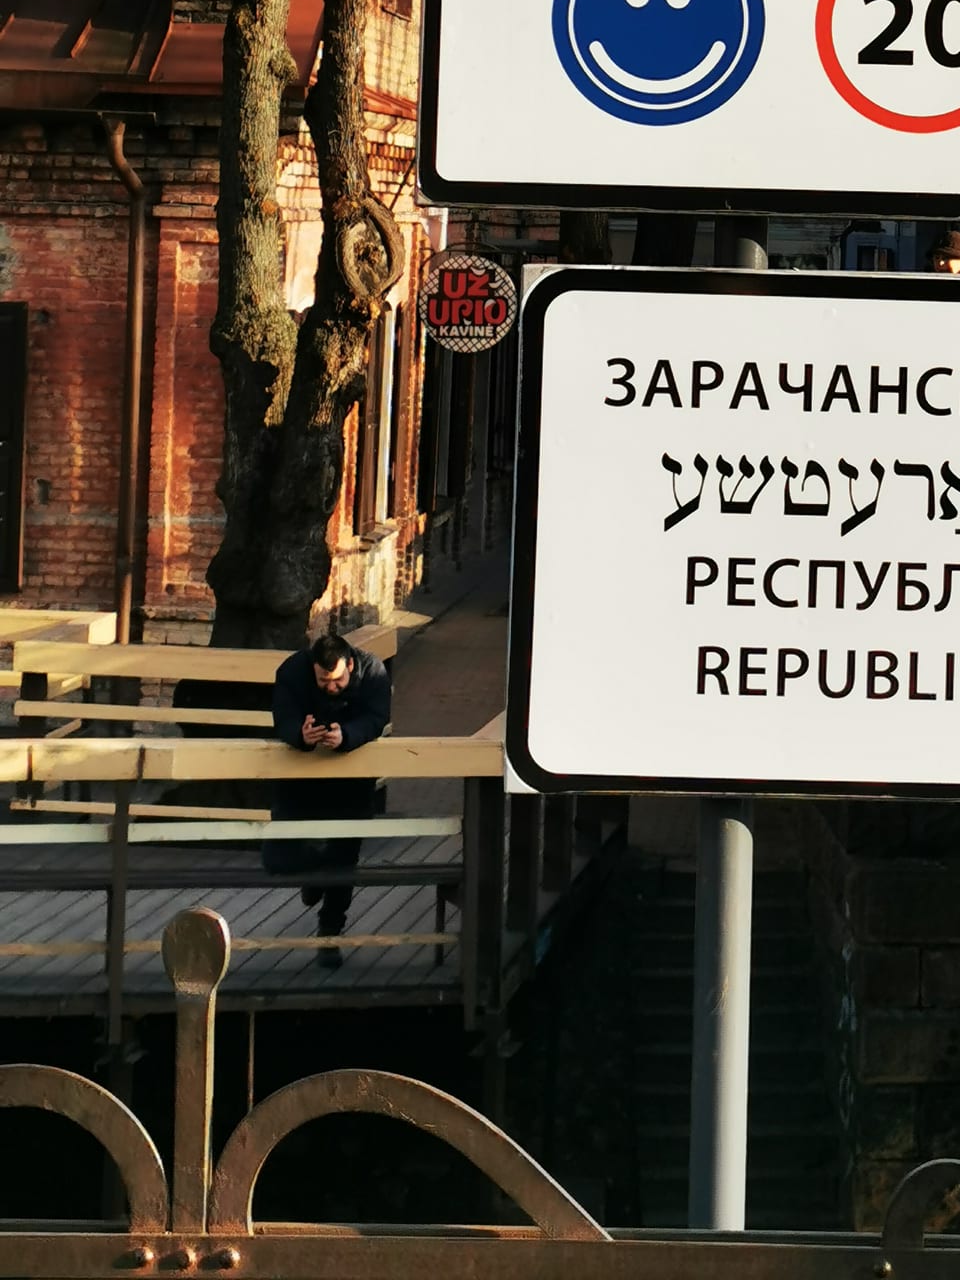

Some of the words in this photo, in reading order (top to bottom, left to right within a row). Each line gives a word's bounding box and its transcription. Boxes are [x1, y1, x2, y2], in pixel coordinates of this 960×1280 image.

[443, 267, 489, 298] UŽ
[429, 298, 507, 325] UPIO
[439, 323, 494, 337] KAVINĖ
